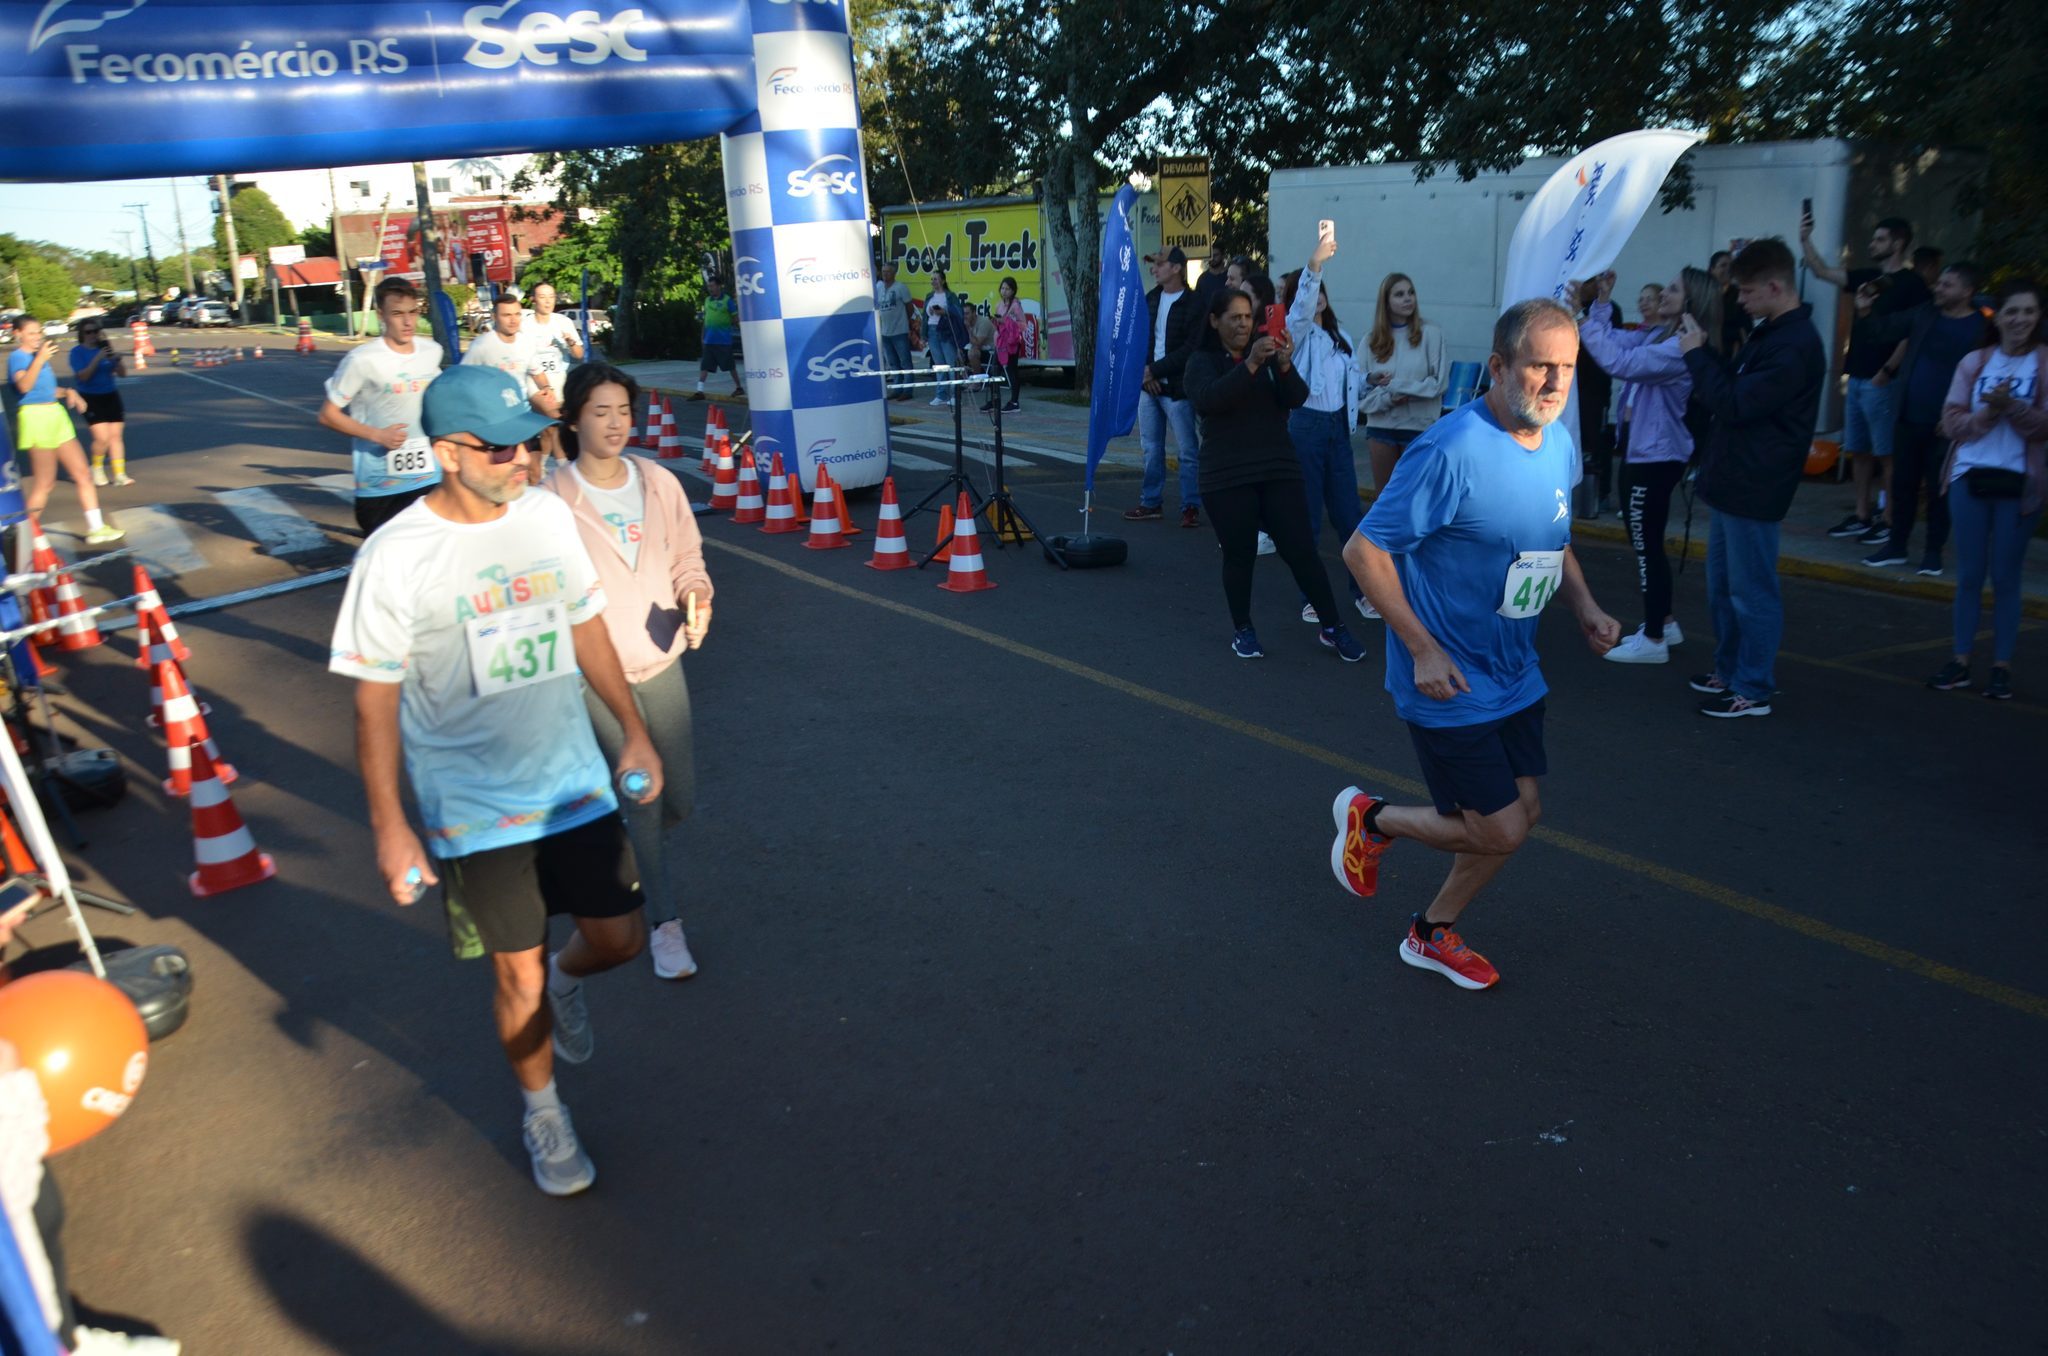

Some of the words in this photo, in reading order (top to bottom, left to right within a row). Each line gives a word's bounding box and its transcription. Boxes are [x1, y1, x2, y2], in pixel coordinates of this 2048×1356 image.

[65, 40, 338, 84] Fecomércio
[349, 38, 408, 75] RS
[1163, 162, 1206, 174] DEVAGAR
[748, 182, 764, 195] RS
[891, 223, 953, 274] Food
[965, 220, 1037, 273] Truck
[958, 293, 991, 317] Tck
[769, 367, 784, 379] RS
[393, 451, 426, 471] 685
[1629, 485, 1648, 550] GROWTH
[488, 630, 558, 683] 437
